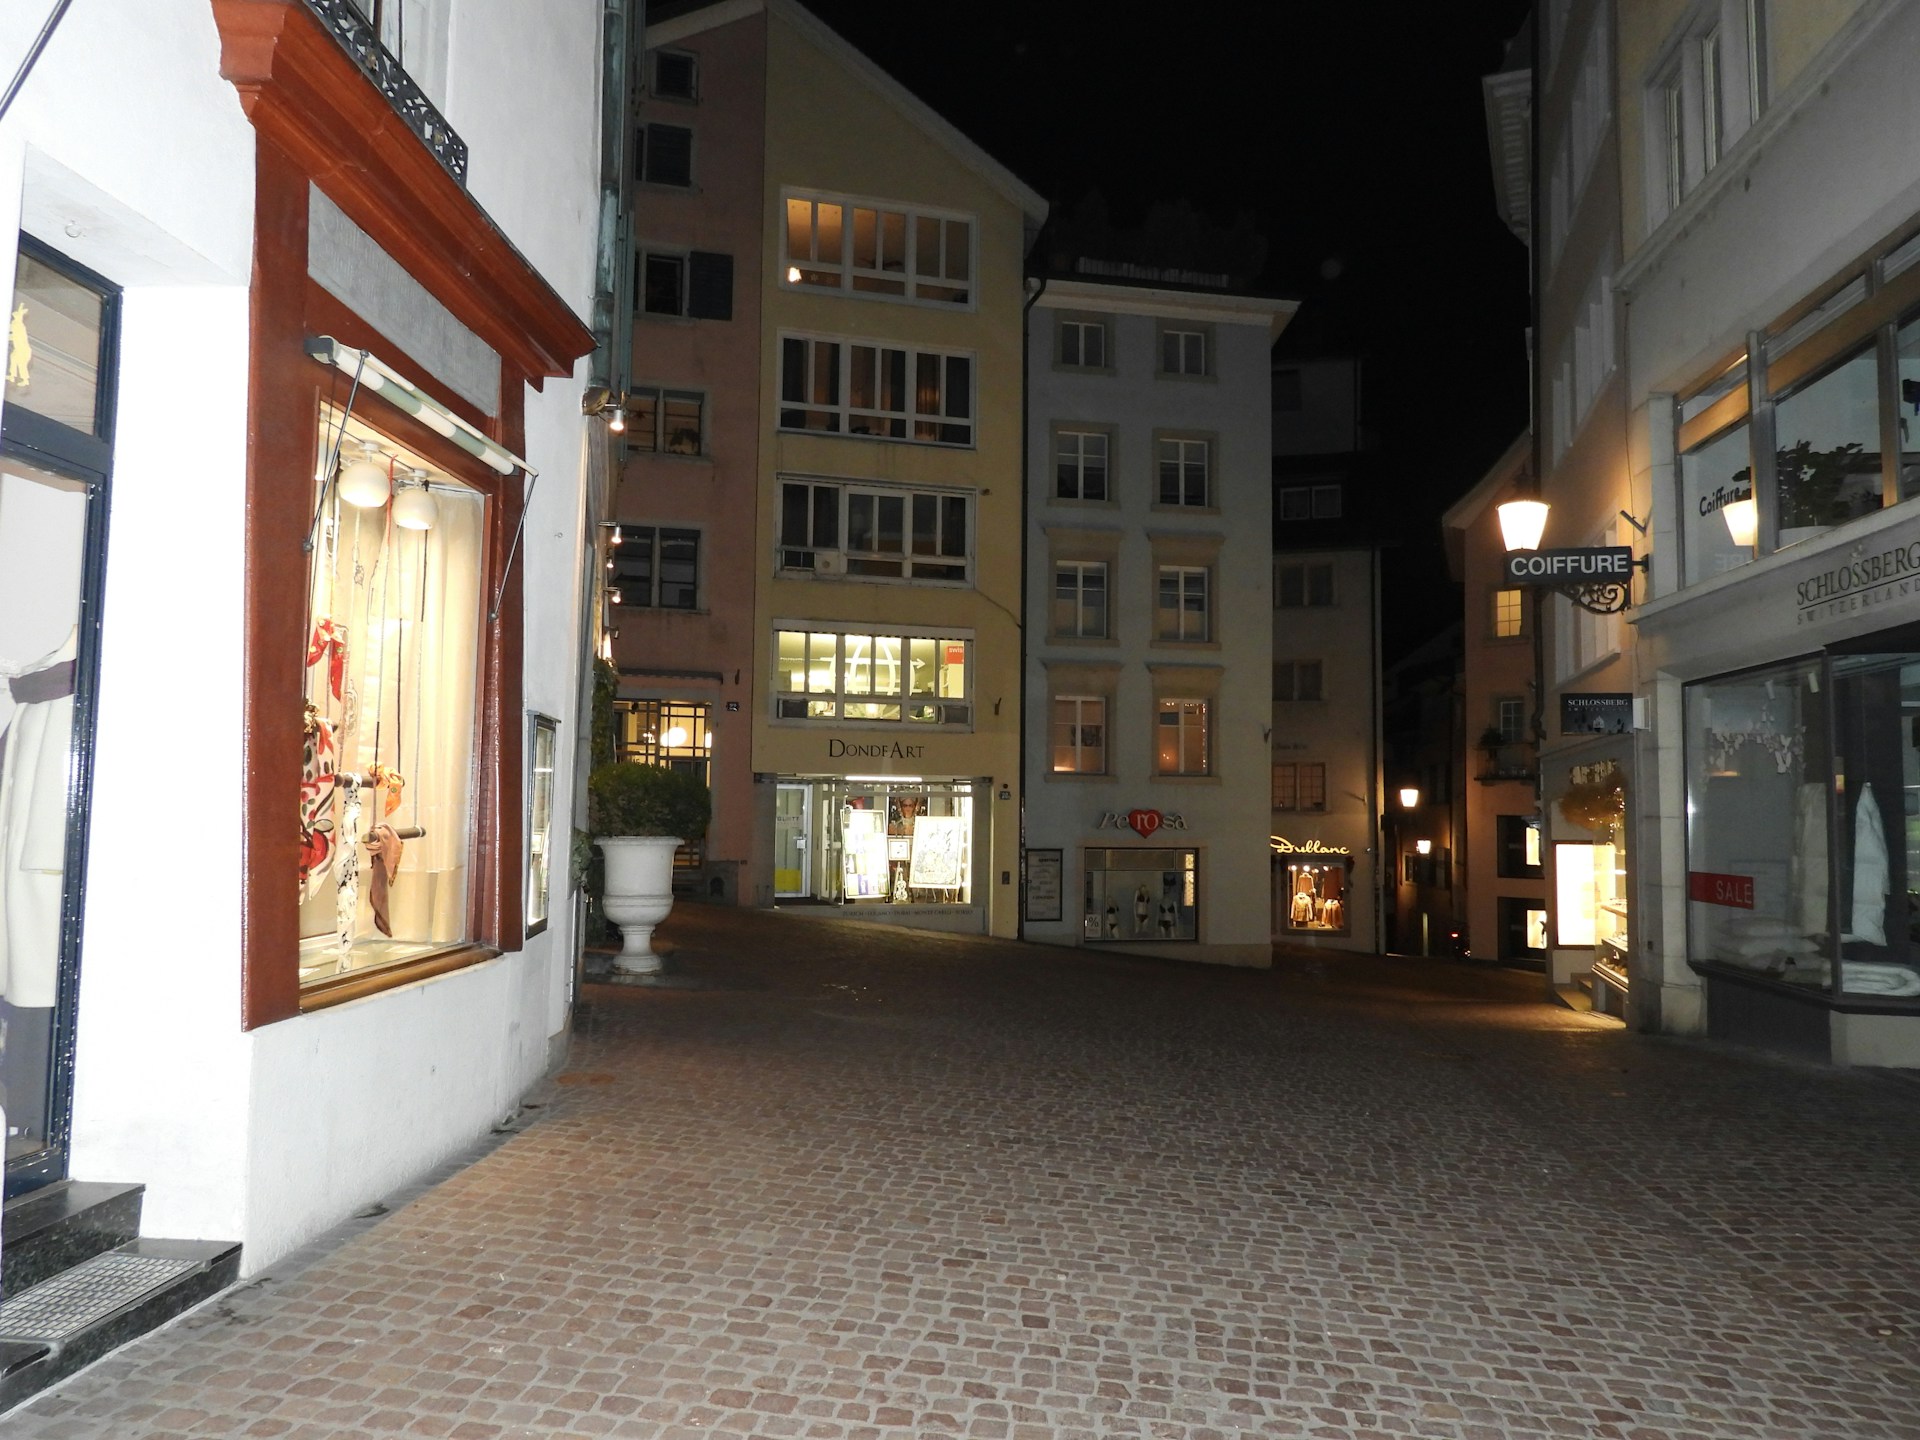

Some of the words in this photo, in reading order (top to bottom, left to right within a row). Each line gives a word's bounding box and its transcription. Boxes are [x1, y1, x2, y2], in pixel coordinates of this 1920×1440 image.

[1699, 486, 1740, 517] Coiffure
[1510, 554, 1629, 576] COIFFURE
[1797, 541, 1920, 606] SCHLOSSBERG
[1270, 835, 1350, 854] Dublanc
[1716, 880, 1753, 905] SALE
